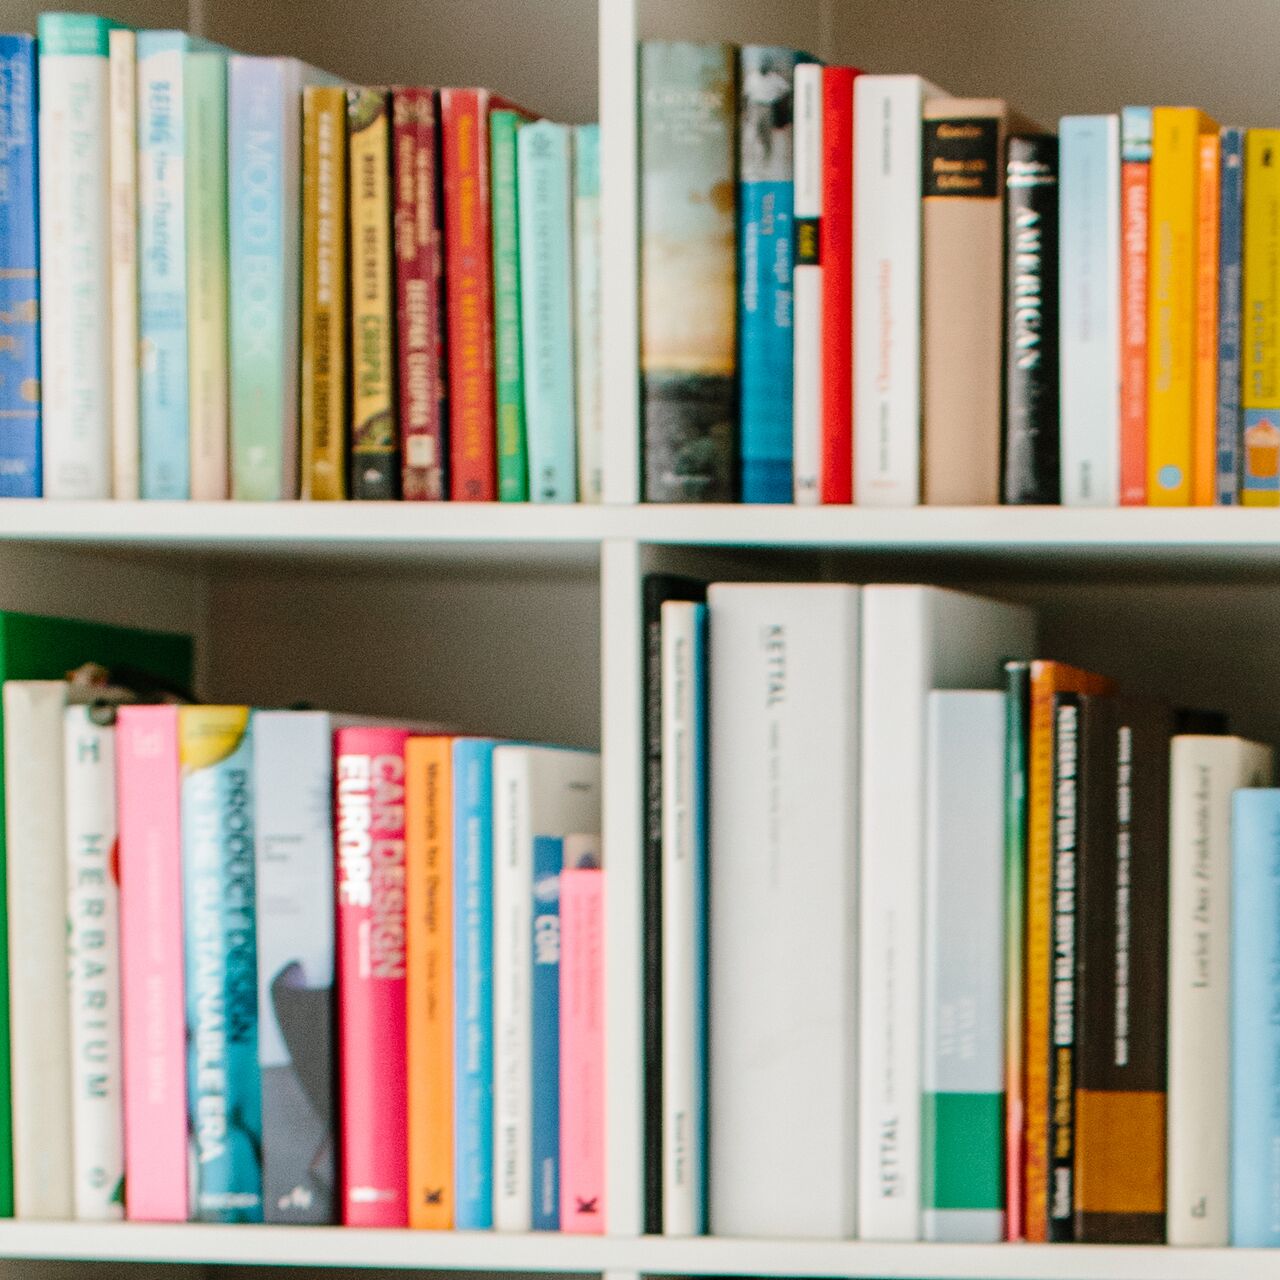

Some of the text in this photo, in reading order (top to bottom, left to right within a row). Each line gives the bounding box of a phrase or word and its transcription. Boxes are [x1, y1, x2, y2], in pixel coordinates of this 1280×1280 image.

[246, 129, 273, 356] MOOD BOOK
[766, 624, 787, 709] KETTAL
[223, 769, 252, 1044] PRODUCT DESIGN
[338, 755, 372, 907] EUROPE
[373, 754, 404, 979] CAR DESIGN
[80, 834, 110, 1100] HERBARIUM
[194, 877, 224, 1088] SUSTAINABLE
[199, 1099, 226, 1163] ERA
[881, 1118, 899, 1198] KETTAL
